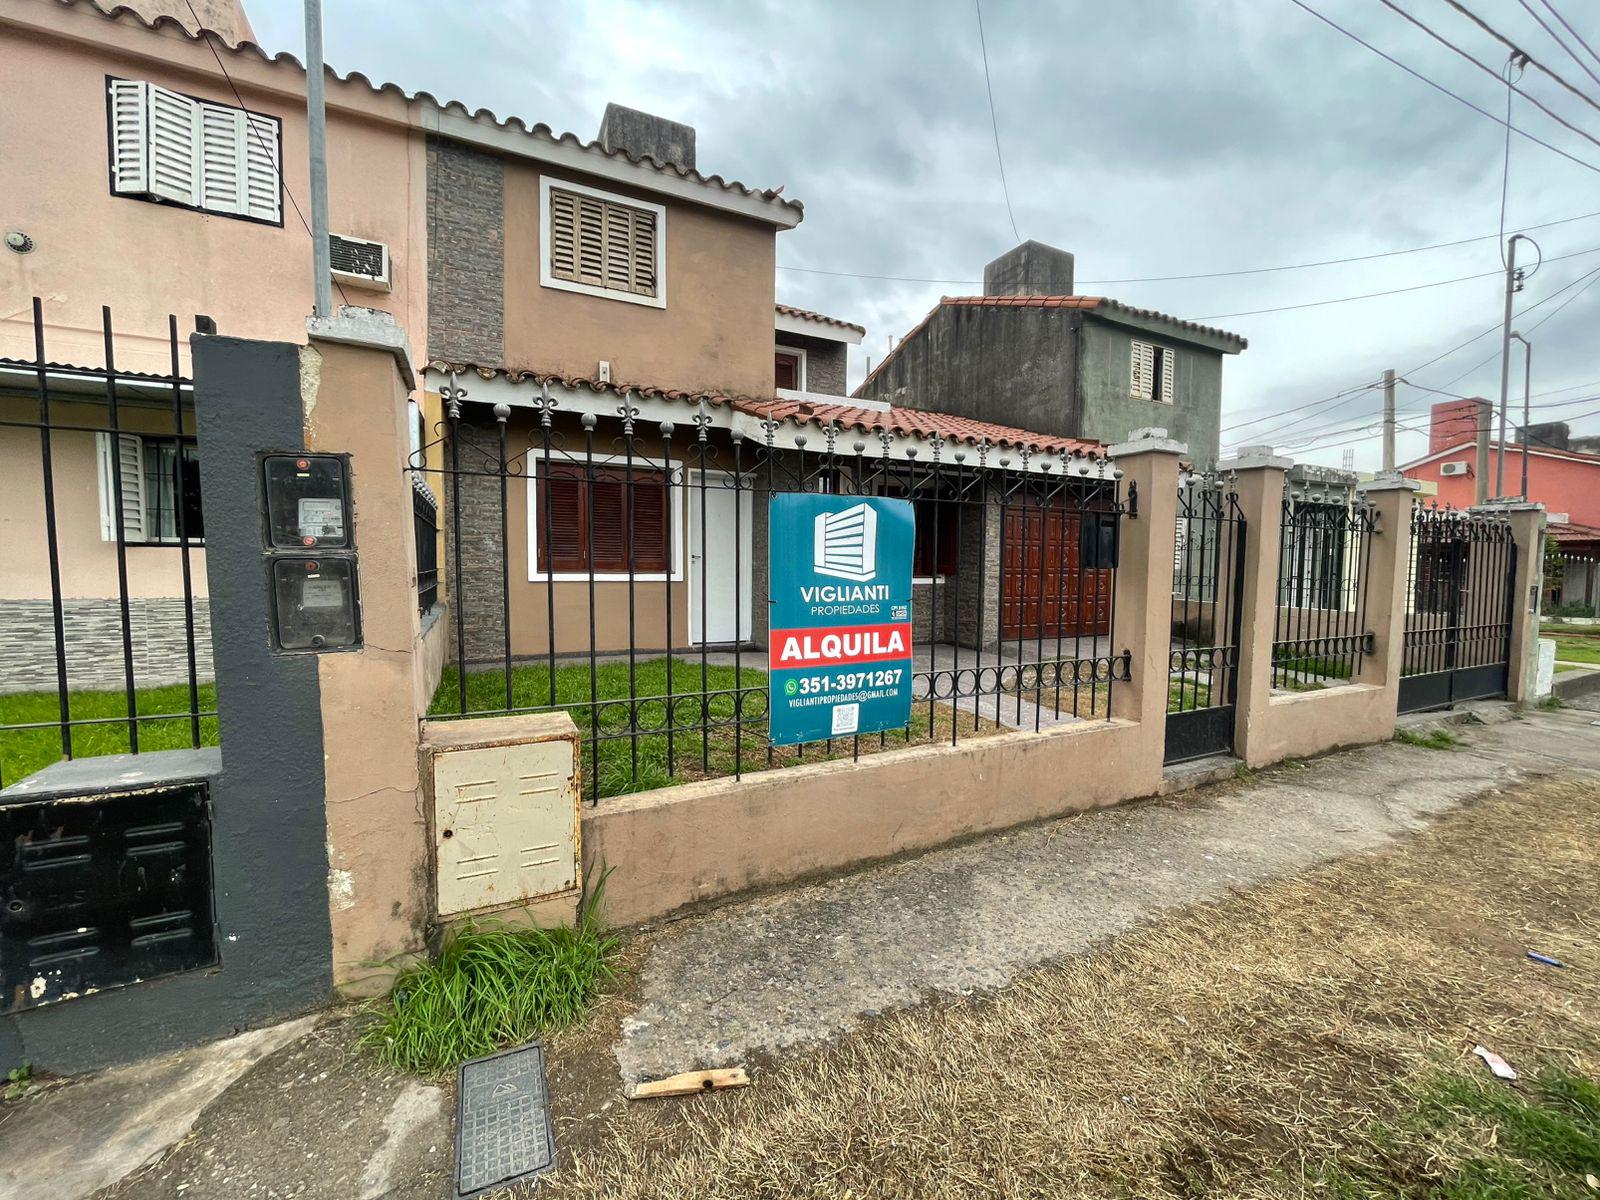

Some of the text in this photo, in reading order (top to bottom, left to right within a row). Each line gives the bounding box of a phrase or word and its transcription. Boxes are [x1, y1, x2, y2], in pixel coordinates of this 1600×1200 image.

[800, 585, 889, 603] VIGLIANTI
[811, 604, 880, 616] PROPIEDADES
[780, 631, 904, 661] ALQUILA
[799, 669, 902, 694] 351-3971267
[789, 688, 898, 708] VIGLIANTIPROPIEDADES@GMAIL.COM
